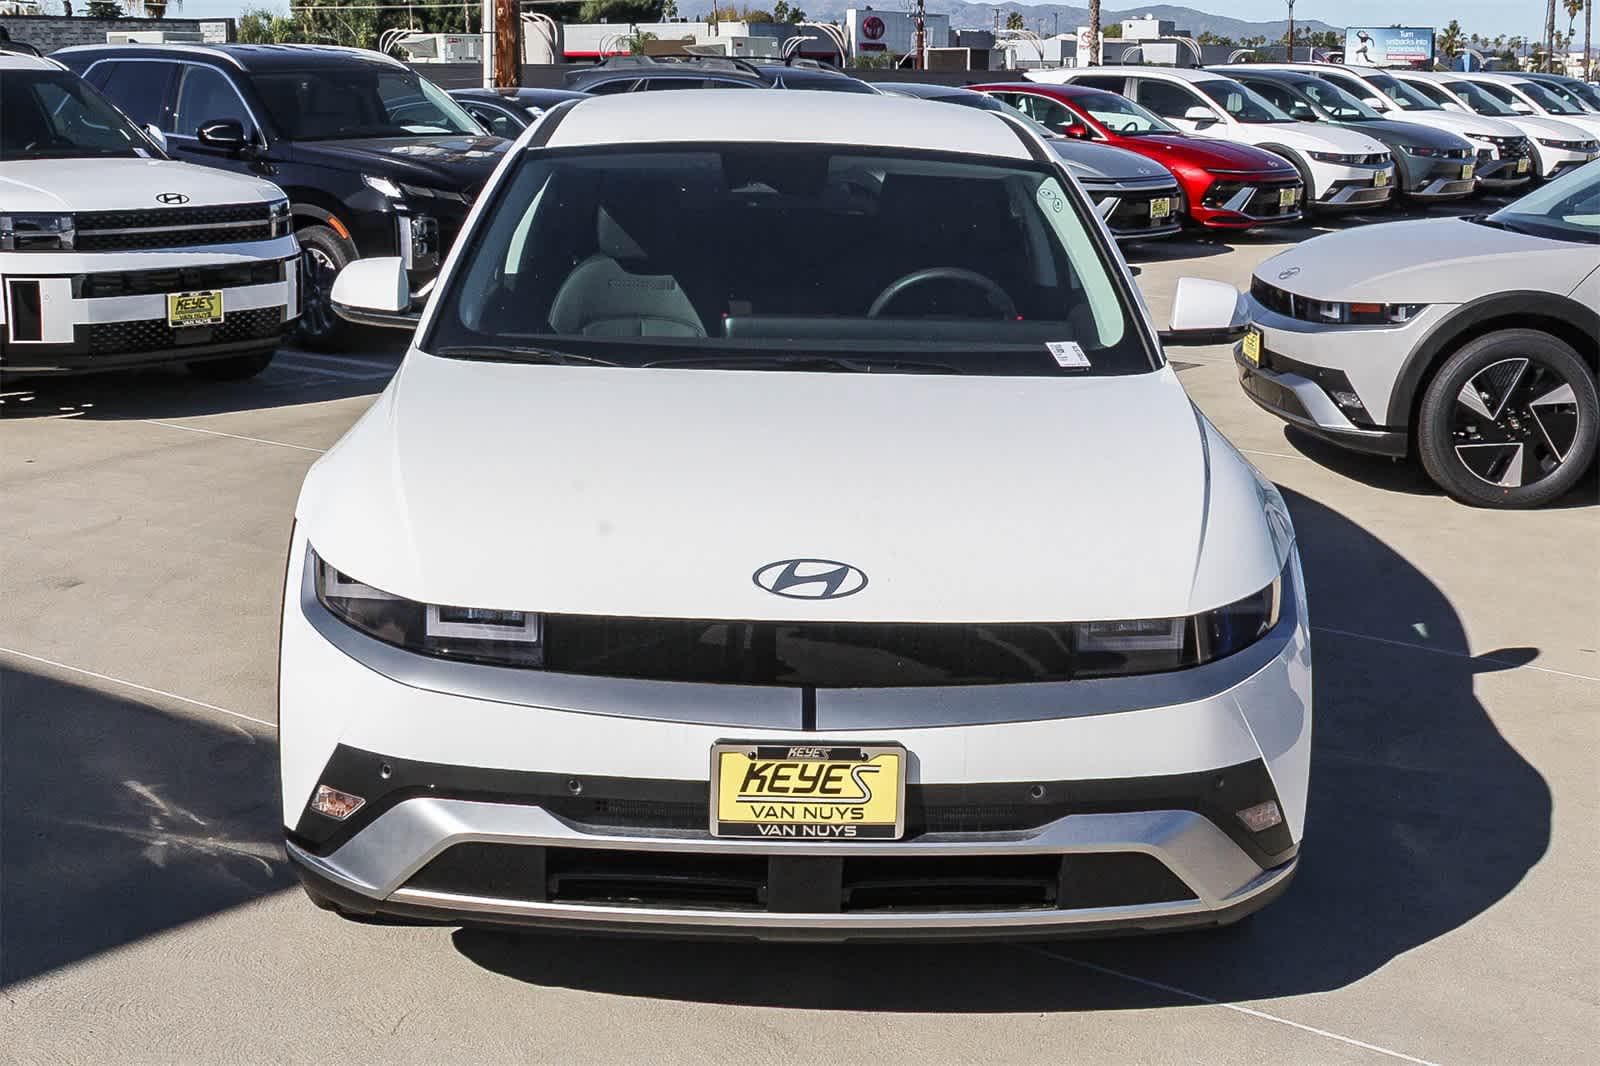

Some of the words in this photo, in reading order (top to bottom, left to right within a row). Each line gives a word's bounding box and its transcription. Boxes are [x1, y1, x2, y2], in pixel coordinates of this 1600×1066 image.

[176, 296, 214, 311] KEYES
[787, 747, 831, 759] KEYES
[736, 763, 882, 803] KEYES
[751, 805, 795, 819] VAN
[803, 806, 864, 820] NUYS
[757, 824, 796, 836] VAN
[802, 825, 857, 837] NUYS
